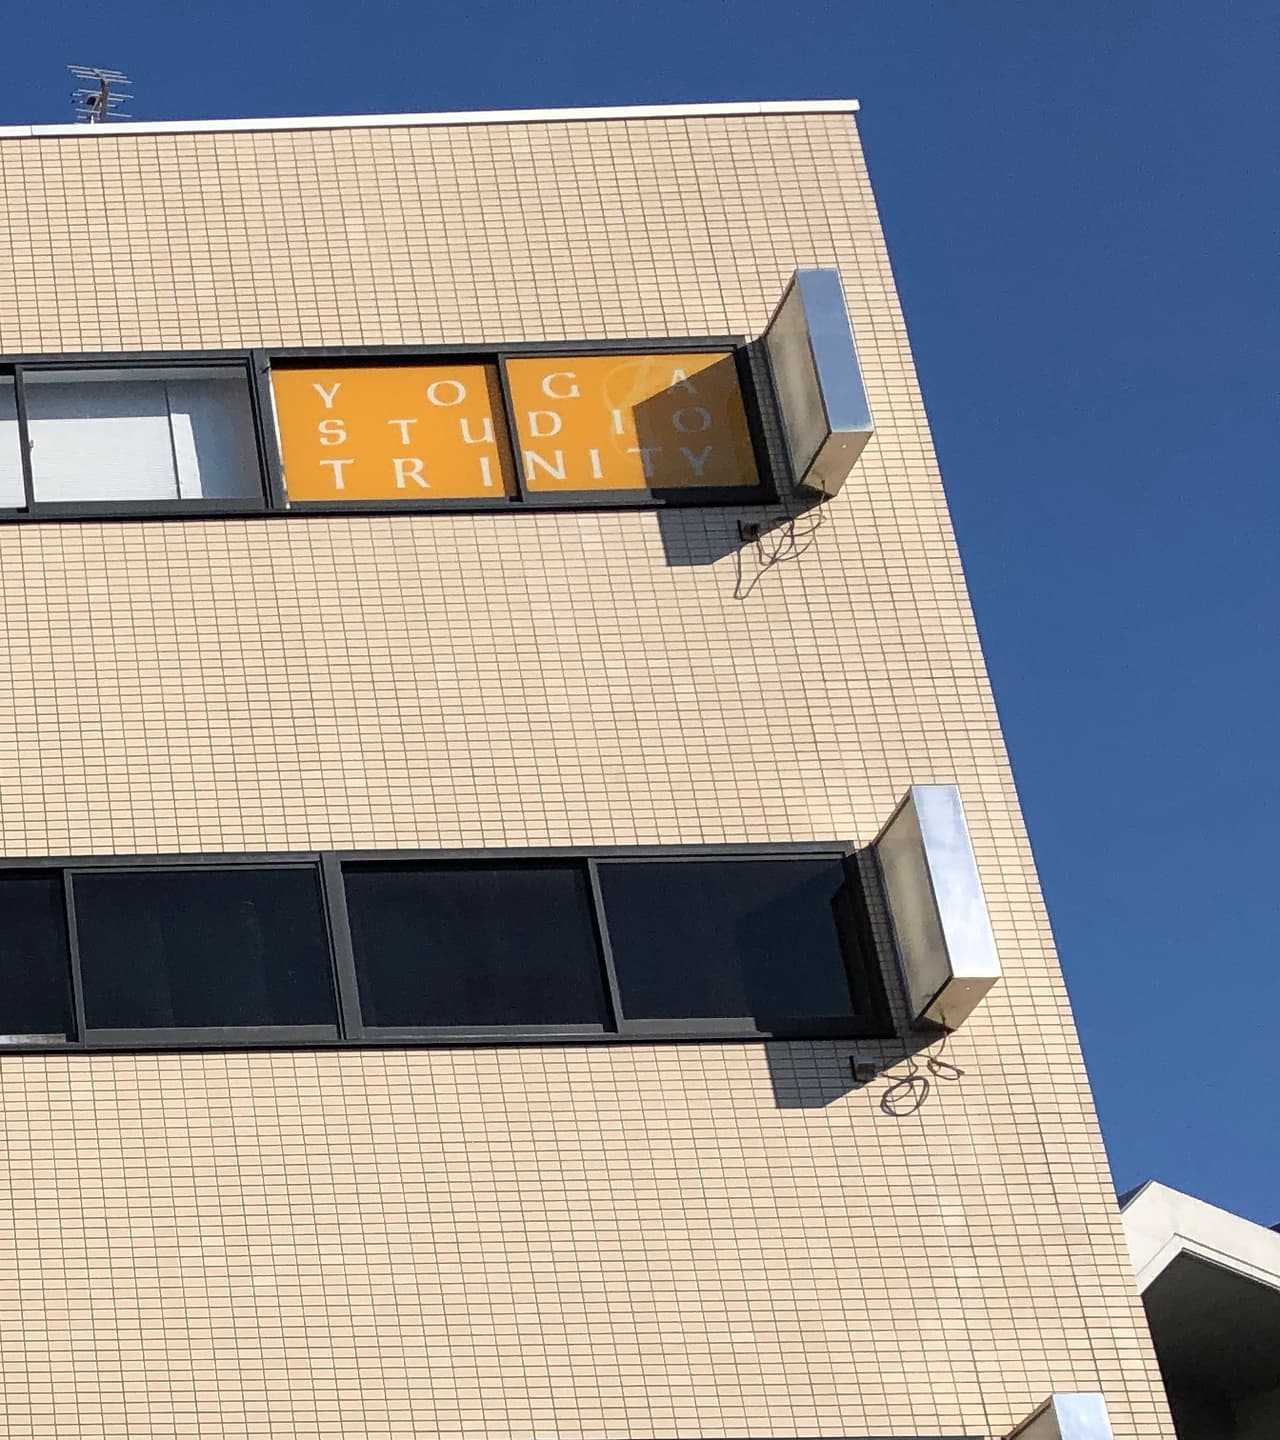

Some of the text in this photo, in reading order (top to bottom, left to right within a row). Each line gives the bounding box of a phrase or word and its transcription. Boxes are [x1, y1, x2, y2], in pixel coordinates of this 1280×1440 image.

[313, 369, 698, 409] YOGA
[318, 407, 712, 446] STUDIO
[320, 446, 712, 490] TRINITY
